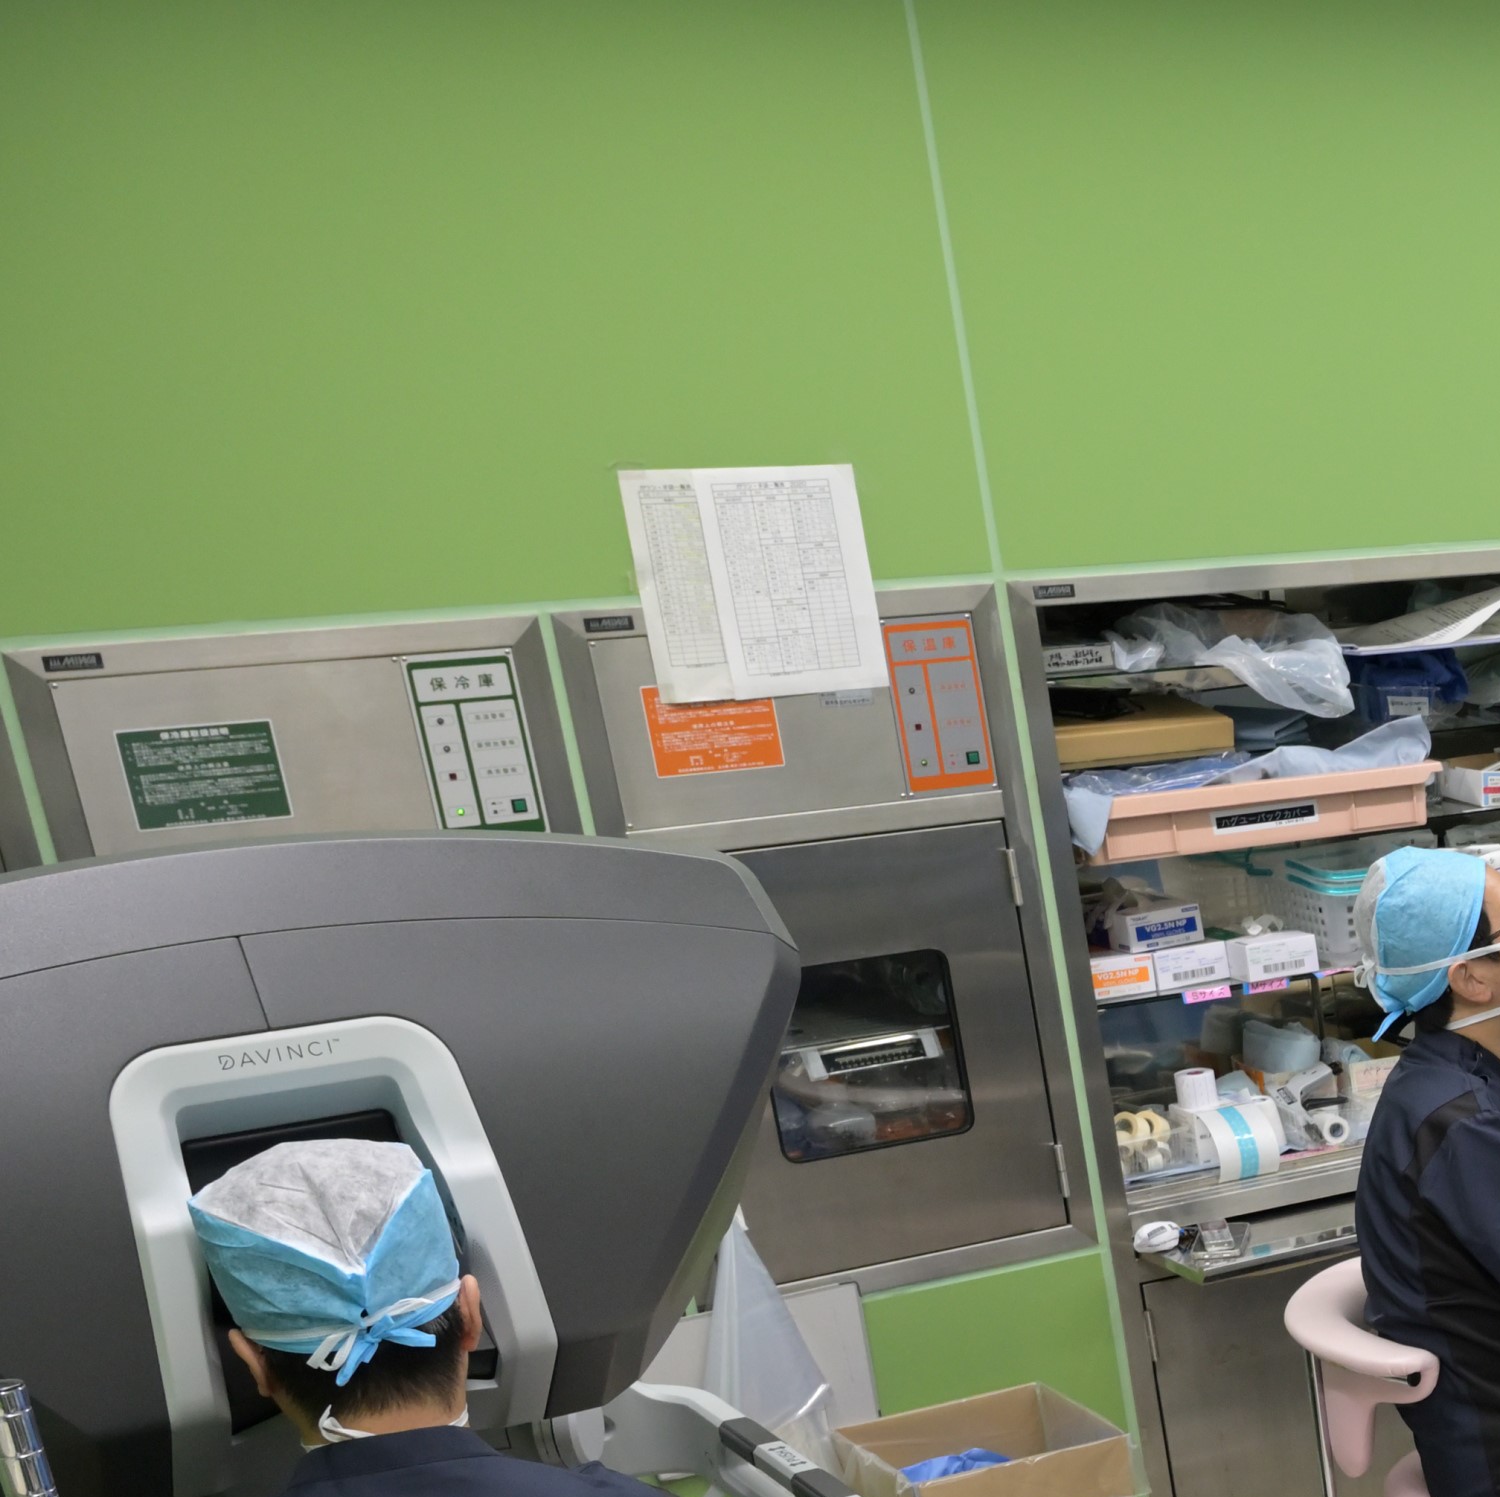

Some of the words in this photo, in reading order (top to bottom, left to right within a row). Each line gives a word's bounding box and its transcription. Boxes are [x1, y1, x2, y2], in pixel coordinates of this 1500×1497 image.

[902, 636, 956, 652] 保温庫
[429, 673, 495, 692] 保冷庫
[1145, 921, 1175, 932] VG2.5N
